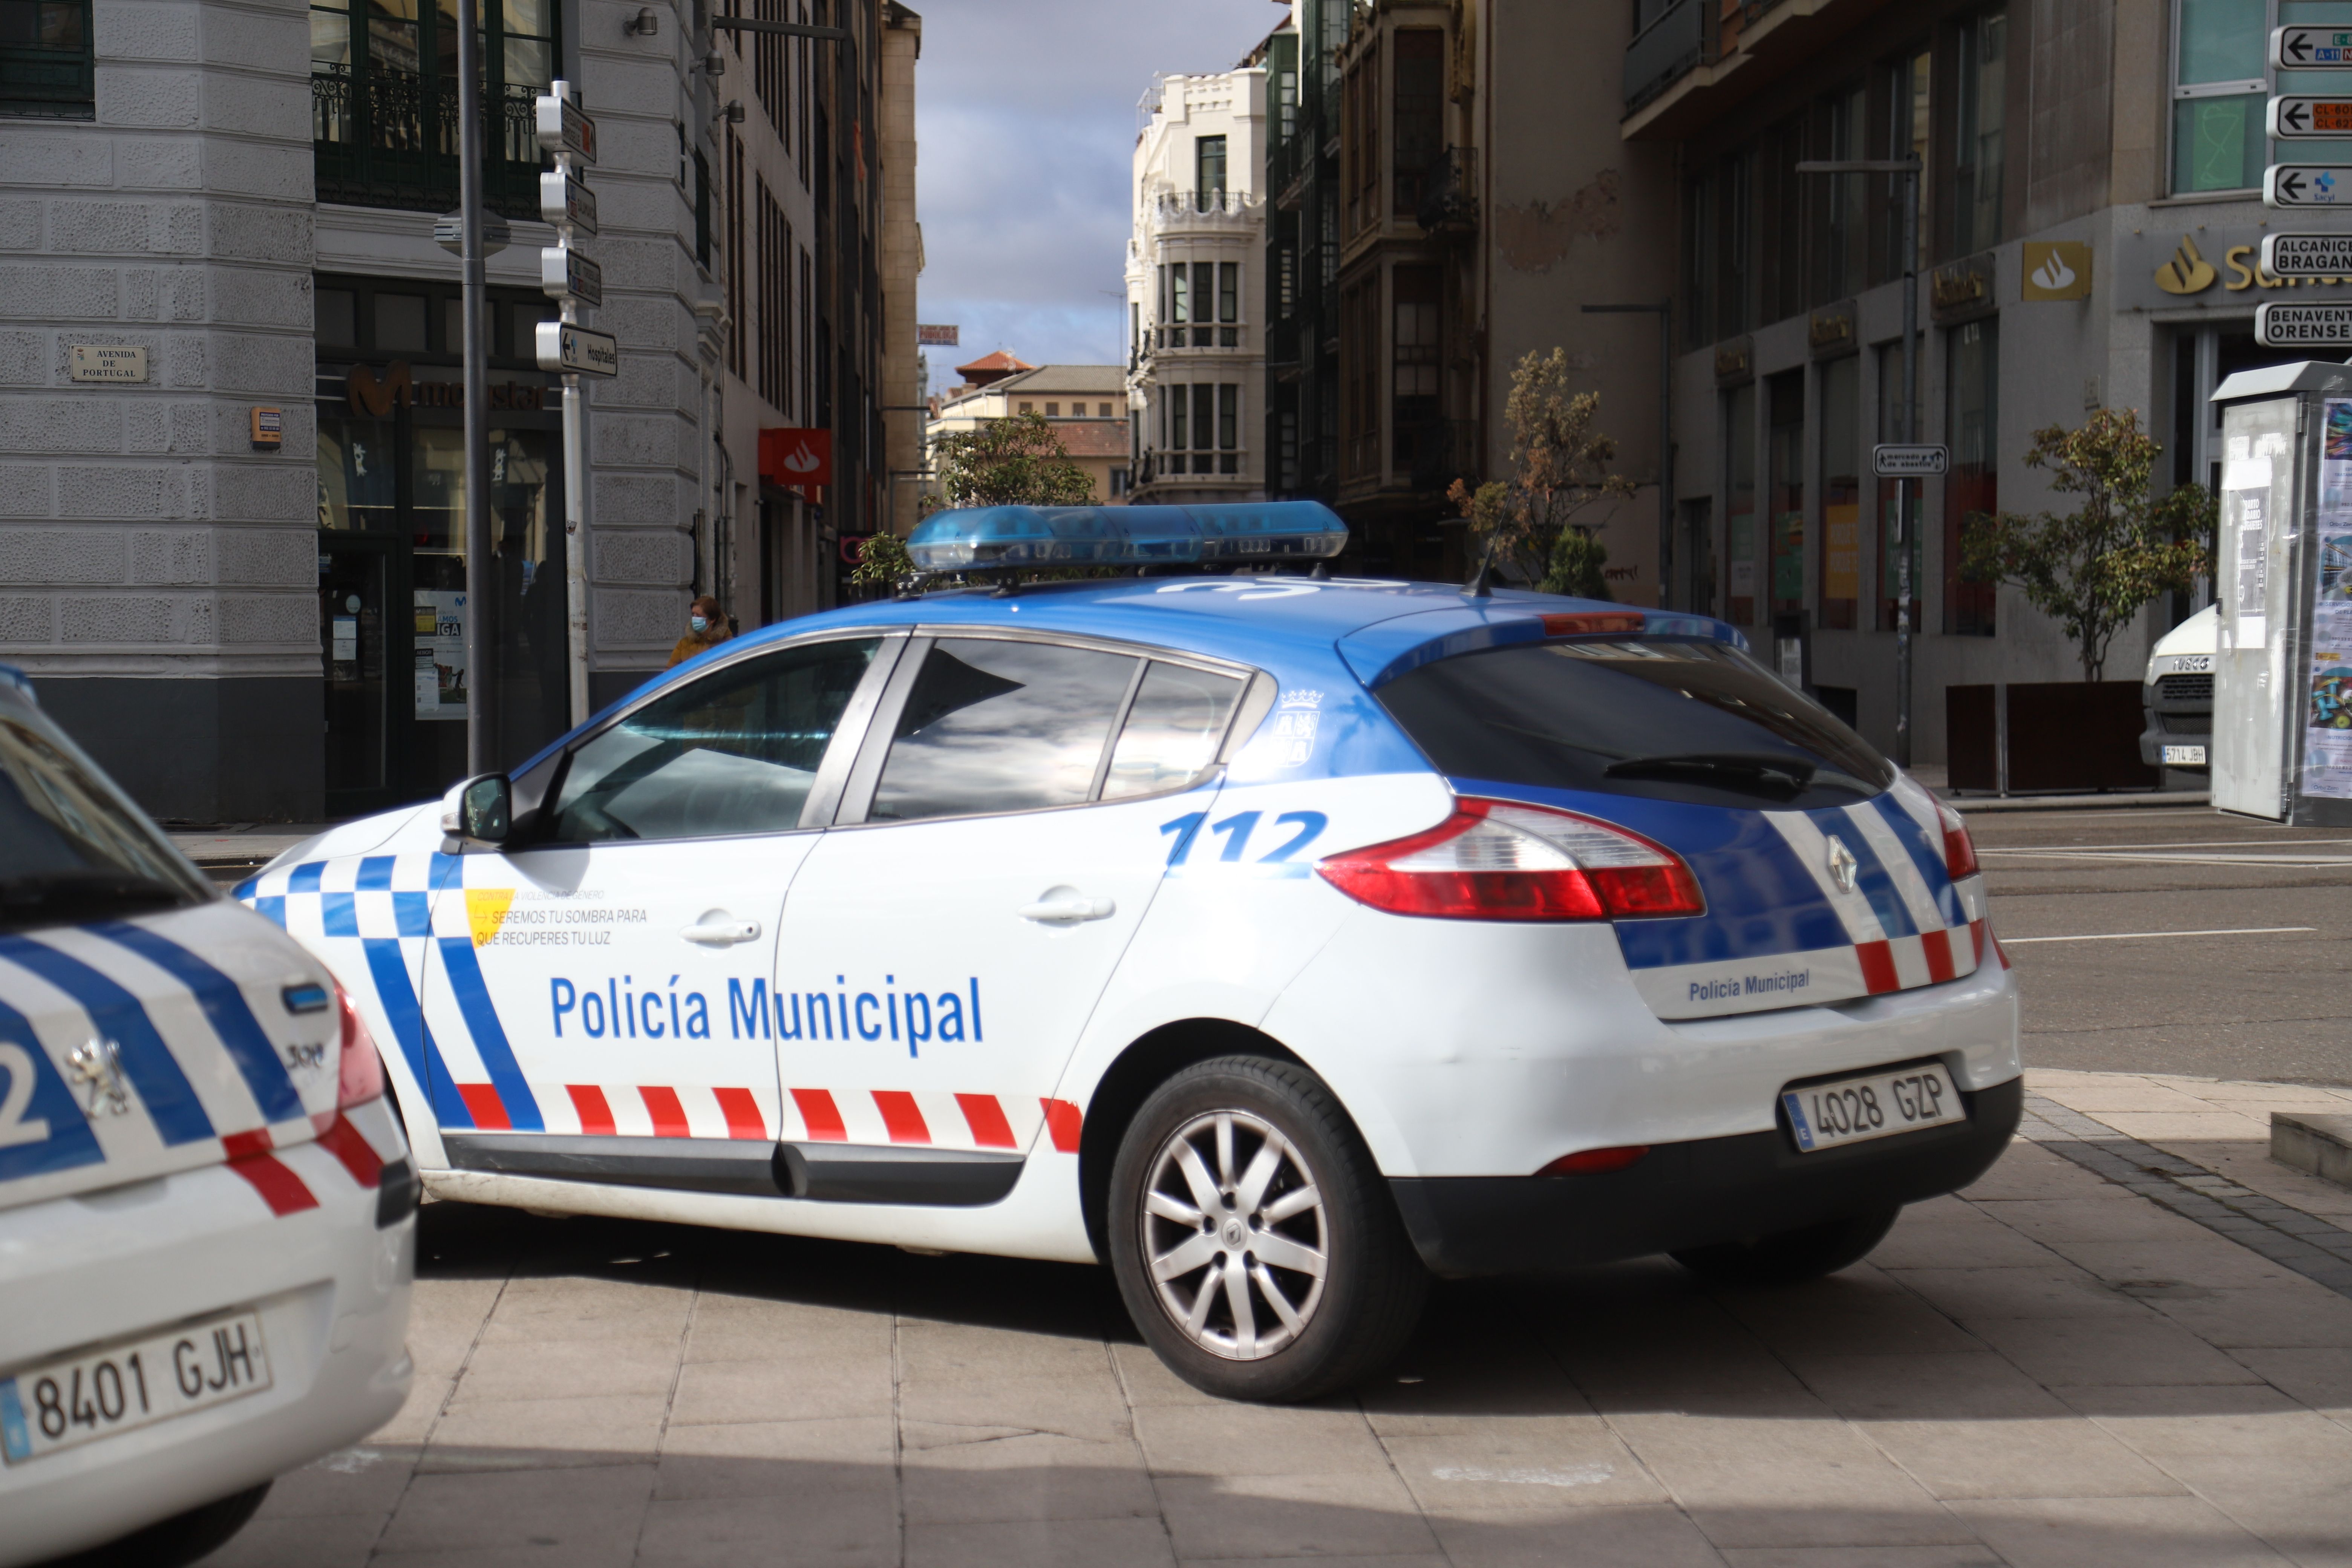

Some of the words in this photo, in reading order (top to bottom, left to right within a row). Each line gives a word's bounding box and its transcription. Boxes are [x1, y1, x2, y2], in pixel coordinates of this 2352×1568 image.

[2317, 49, 2339, 60] A-11
[2314, 193, 2335, 203] Sacyl
[2271, 325, 2349, 338] ORENSE
[587, 343, 615, 366] Hospitales
[418, 380, 548, 411] moistar
[2173, 657, 2210, 671] IVECO
[2167, 748, 2186, 761] 5714
[2189, 748, 2204, 761] JBH
[1159, 810, 1329, 879] 112
[477, 891, 508, 901] CONTRA
[509, 891, 519, 900] LA
[521, 891, 559, 900] VIOLENCIA
[560, 891, 570, 900] DE
[572, 888, 604, 899] GÉNERO
[491, 910, 545, 924] SEREMOS
[548, 910, 563, 923] TU
[565, 910, 614, 923] SOMBRA
[616, 909, 647, 923] PARA
[476, 931, 499, 946] QUE
[502, 931, 568, 945] RECUPERES
[571, 931, 586, 945] TU
[588, 931, 610, 945] LUZ
[1690, 978, 1740, 1001] Policía
[1746, 968, 1809, 995] Municipal
[550, 974, 711, 1039] Policía
[727, 974, 983, 1058] Municipal
[1814, 1086, 1884, 1138] 4028
[1893, 1073, 1943, 1122] GZP
[1801, 1128, 1809, 1140] E
[34, 1351, 149, 1439] 8401
[172, 1322, 254, 1400] GJH
